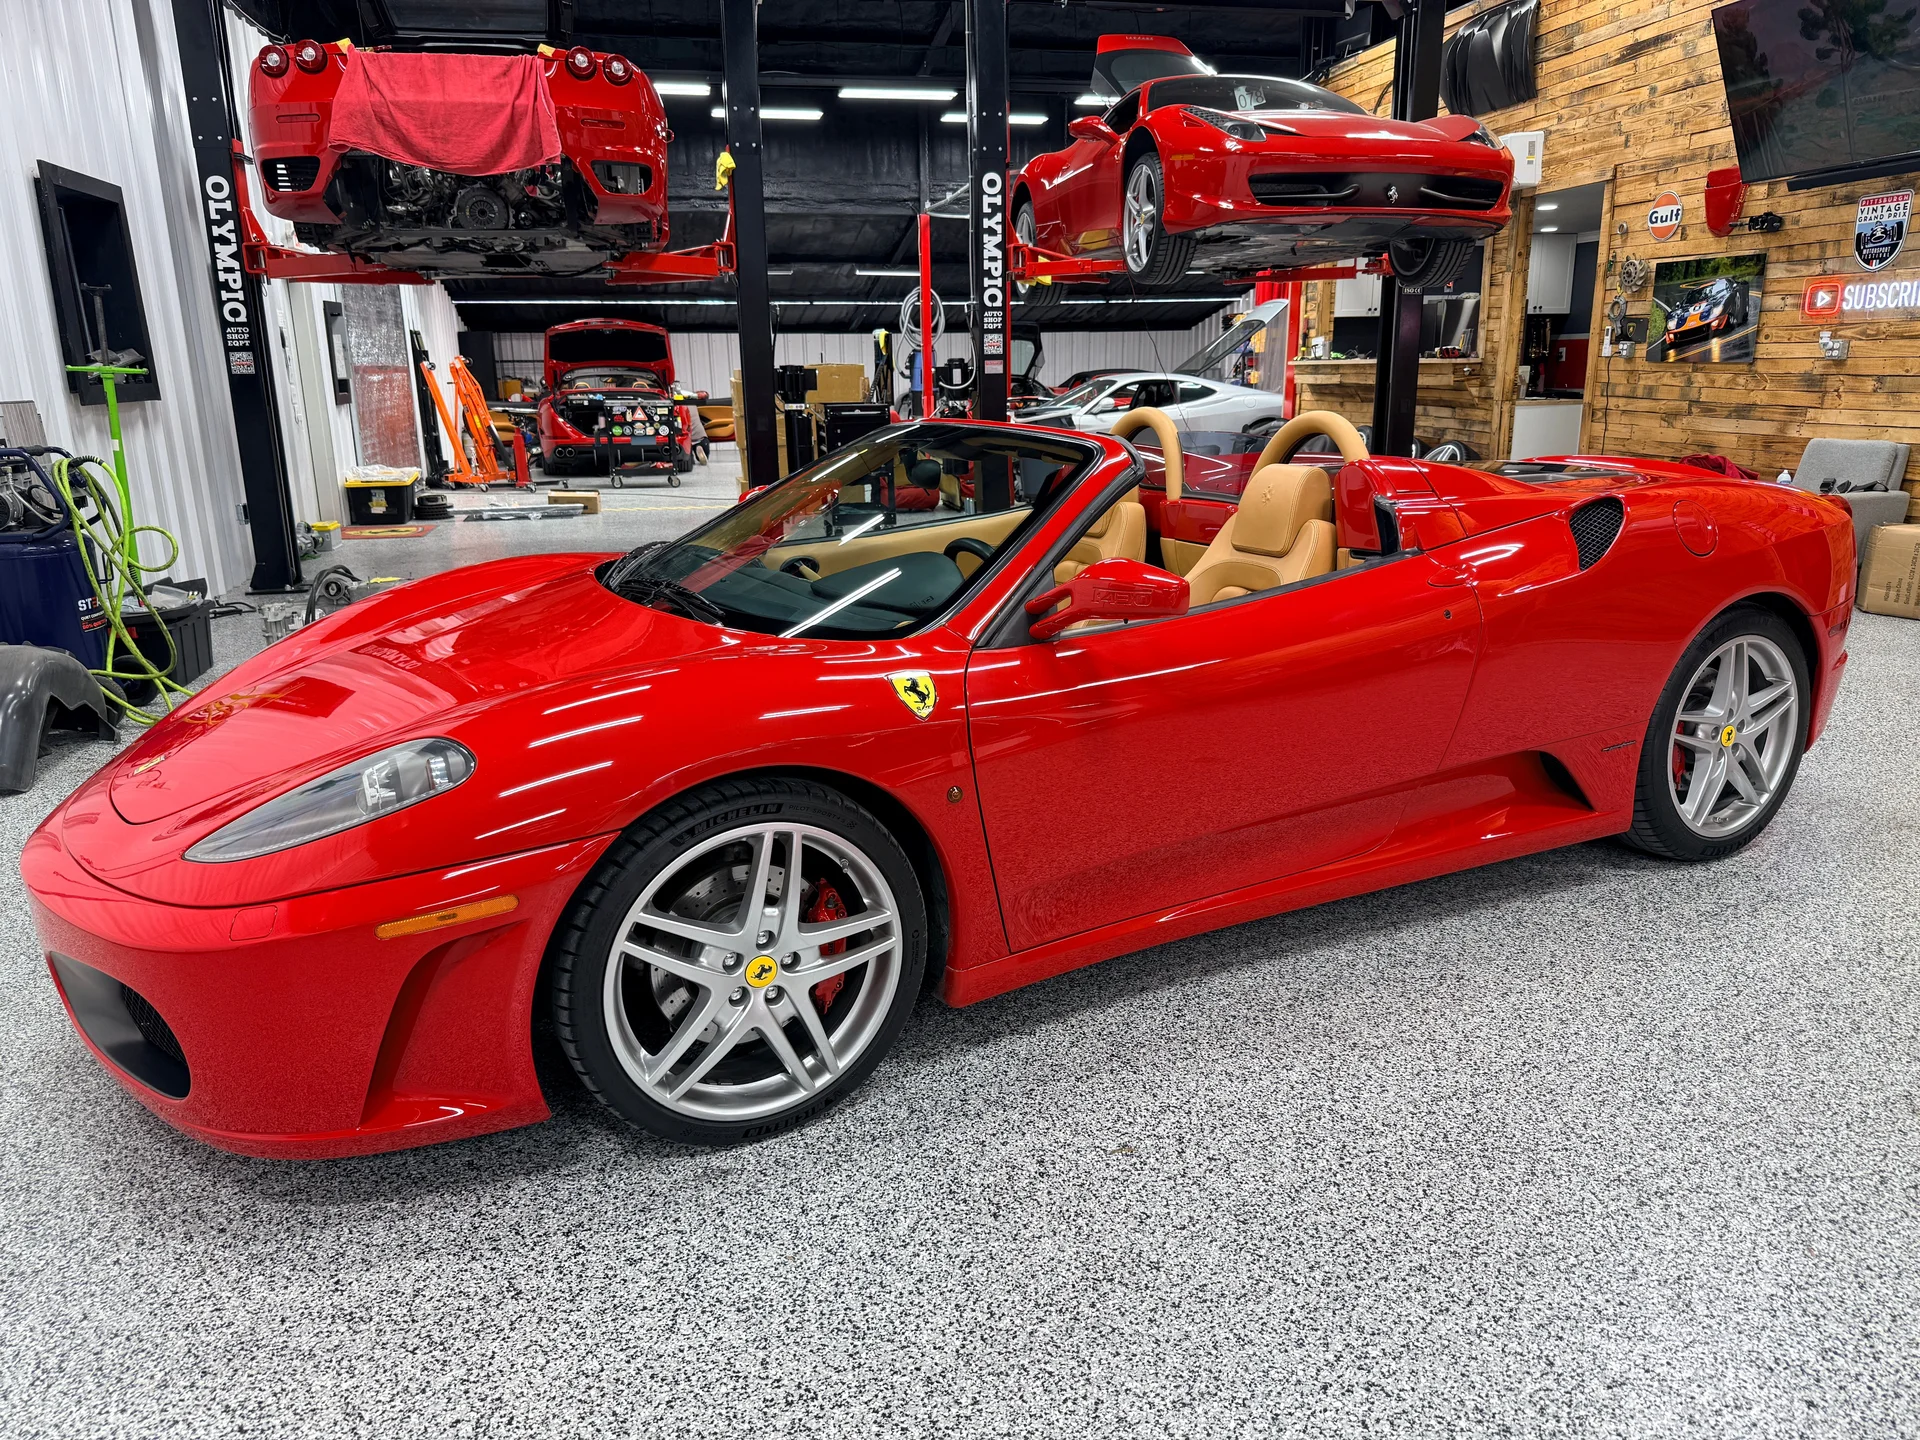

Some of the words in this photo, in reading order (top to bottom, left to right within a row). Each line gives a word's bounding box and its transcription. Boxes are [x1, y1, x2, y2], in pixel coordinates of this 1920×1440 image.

[1238, 91, 1264, 108] 078
[1860, 202, 1909, 215] VINTAGE
[1861, 194, 1909, 206] PITTSBURGH
[1649, 208, 1681, 225] Gulf
[1858, 214, 1885, 222] GRAND
[1887, 211, 1907, 219] PRIX
[982, 172, 1003, 307] OLYMPIC
[205, 175, 247, 323] OLYMPIC
[693, 803, 779, 834] MICHELIN
